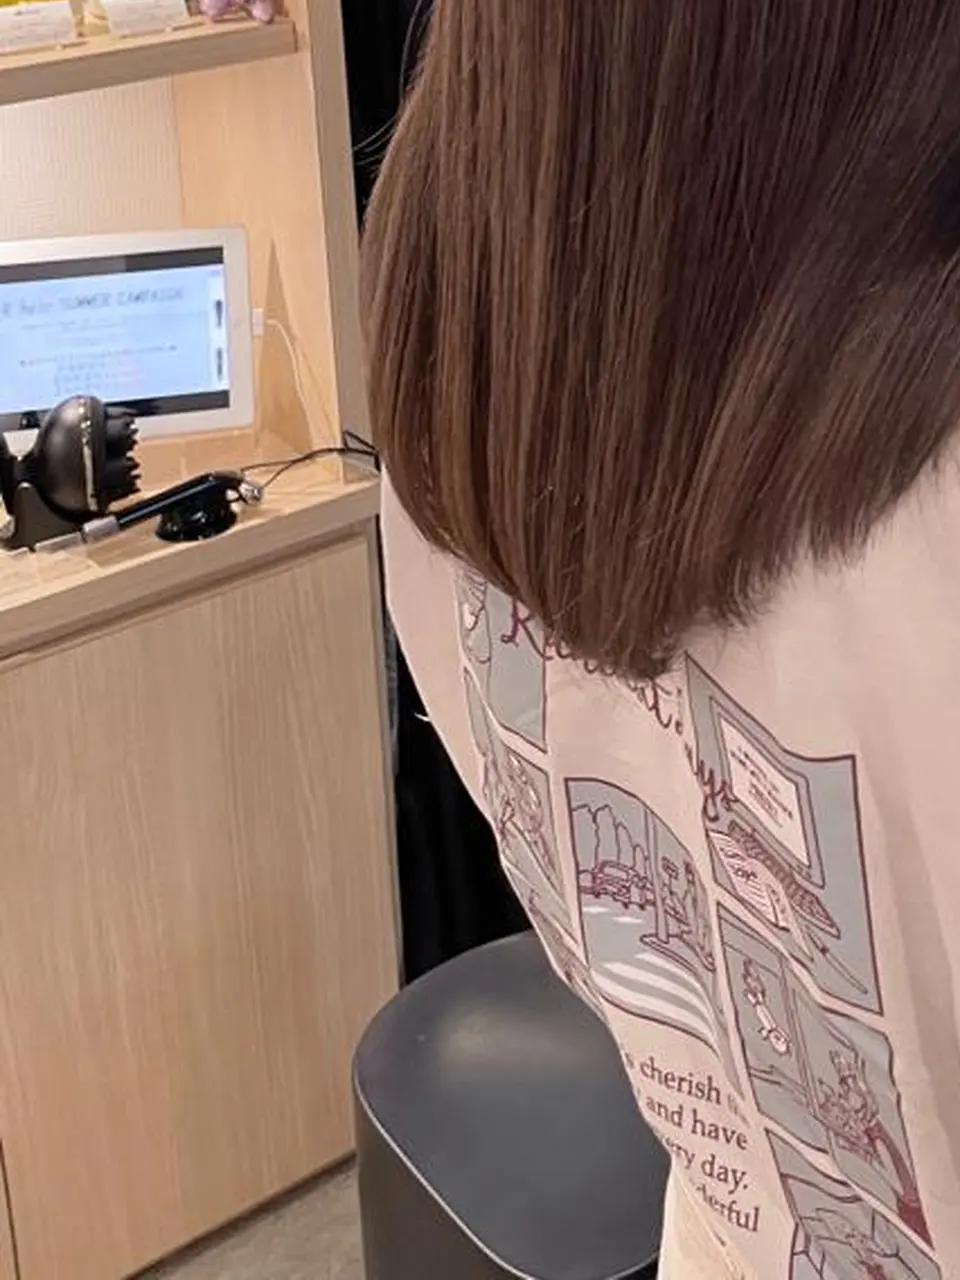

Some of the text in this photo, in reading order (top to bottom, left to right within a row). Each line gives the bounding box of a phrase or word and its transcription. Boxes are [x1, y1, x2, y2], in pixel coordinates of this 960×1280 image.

[640, 1056, 721, 1105] cherish
[646, 1096, 684, 1129] and
[691, 1108, 748, 1150] have
[701, 1153, 748, 1195] day.
